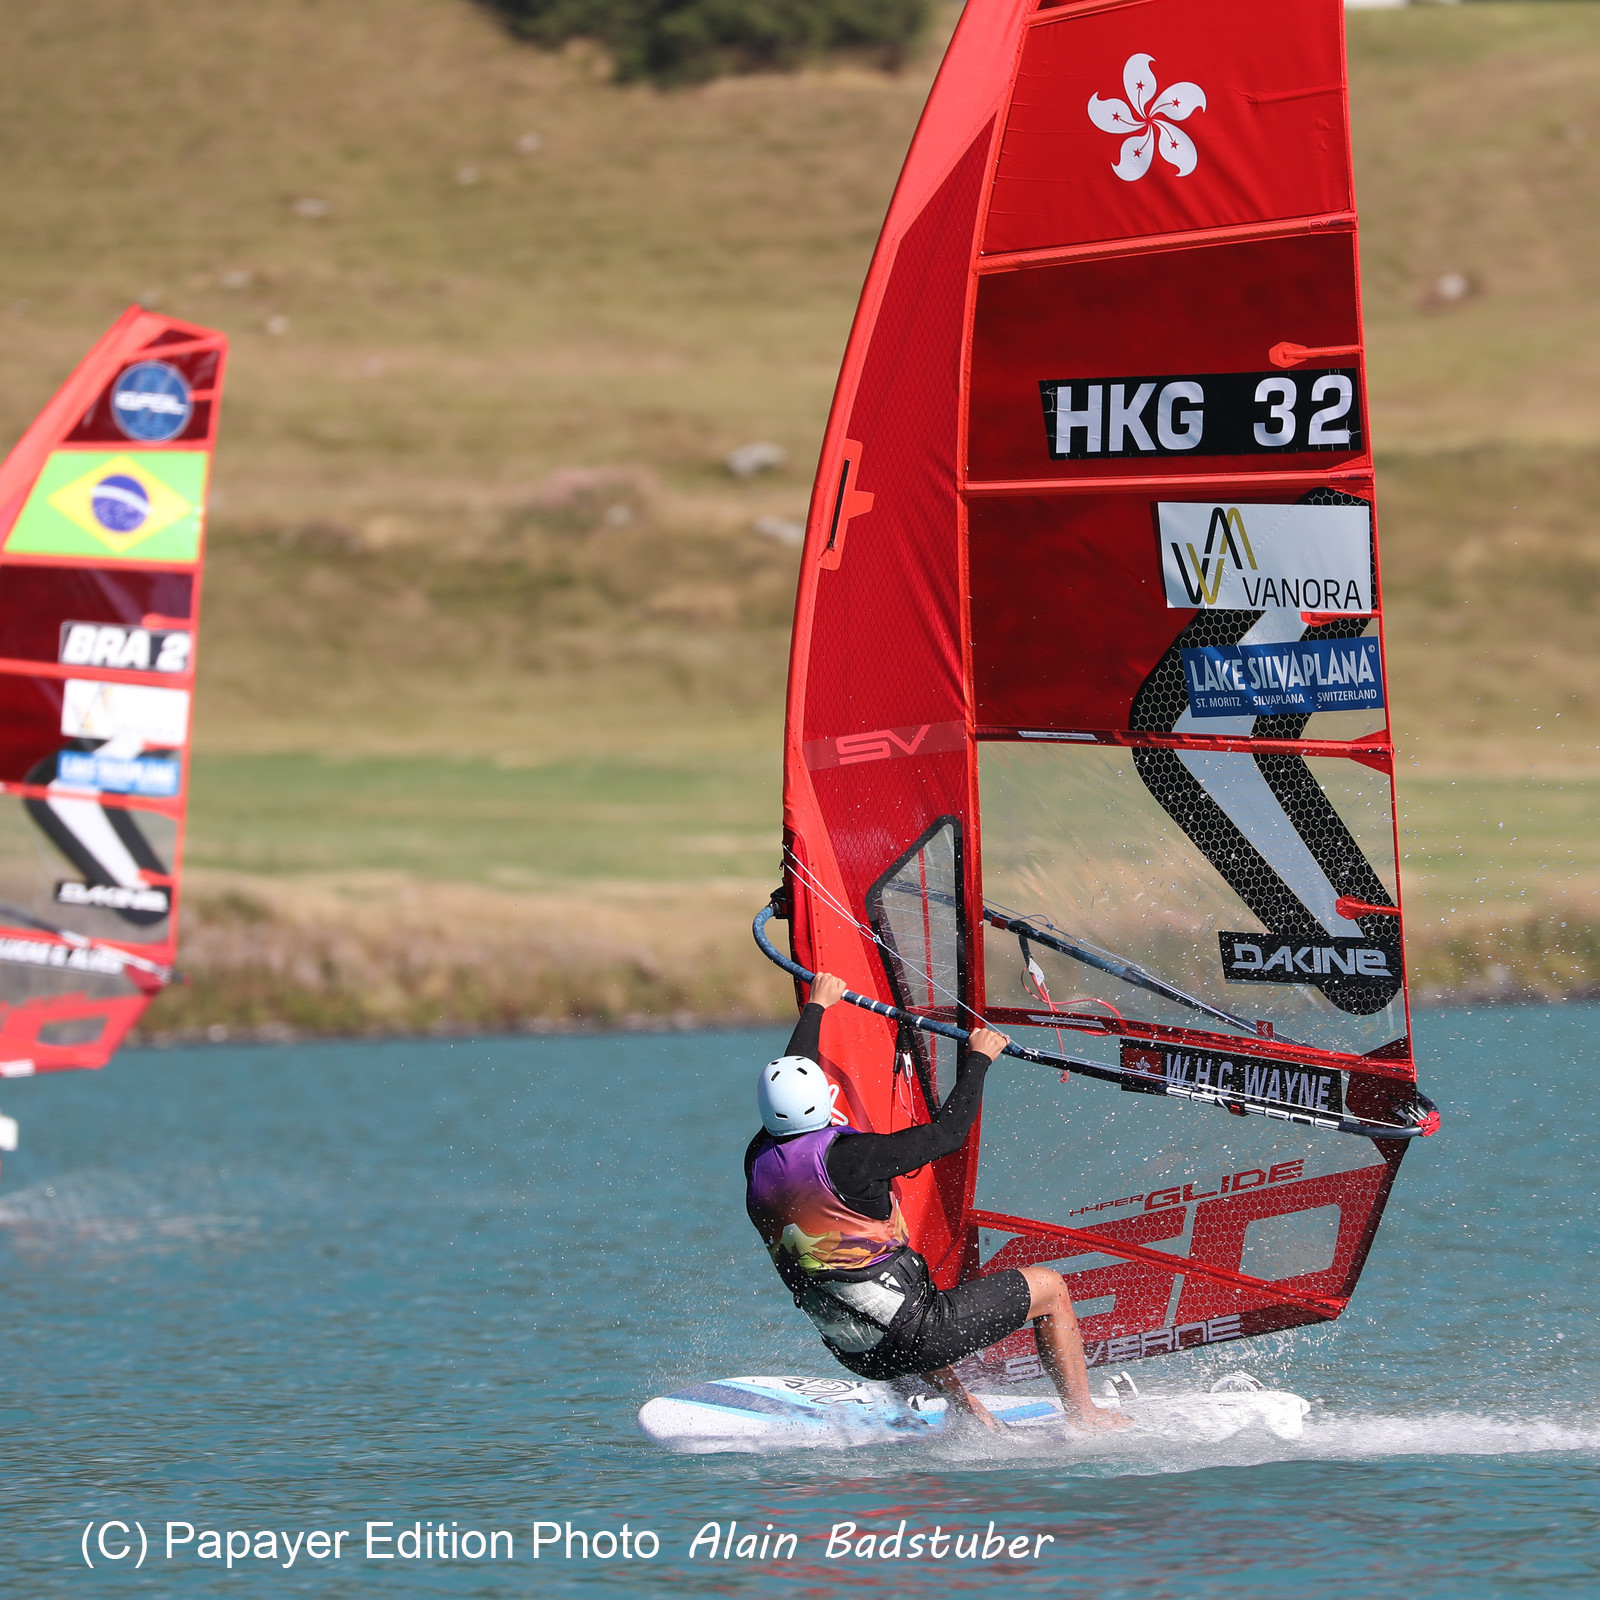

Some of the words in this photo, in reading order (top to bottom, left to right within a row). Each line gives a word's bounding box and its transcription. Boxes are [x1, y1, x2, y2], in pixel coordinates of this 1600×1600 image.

[1055, 381, 1205, 454] HKG
[1253, 374, 1353, 447] 32
[1242, 576, 1363, 610] VANORA
[63, 624, 149, 668] BRA
[156, 631, 191, 671] 2
[1189, 655, 1247, 692] LAKE
[1196, 697, 1208, 708] ST.
[1209, 696, 1242, 708] MORITZ
[1252, 693, 1305, 706] SILVAPLANA
[1317, 688, 1378, 703] SWITZERLAND
[835, 724, 931, 765] SV
[1244, 1063, 1331, 1112] WAYNE
